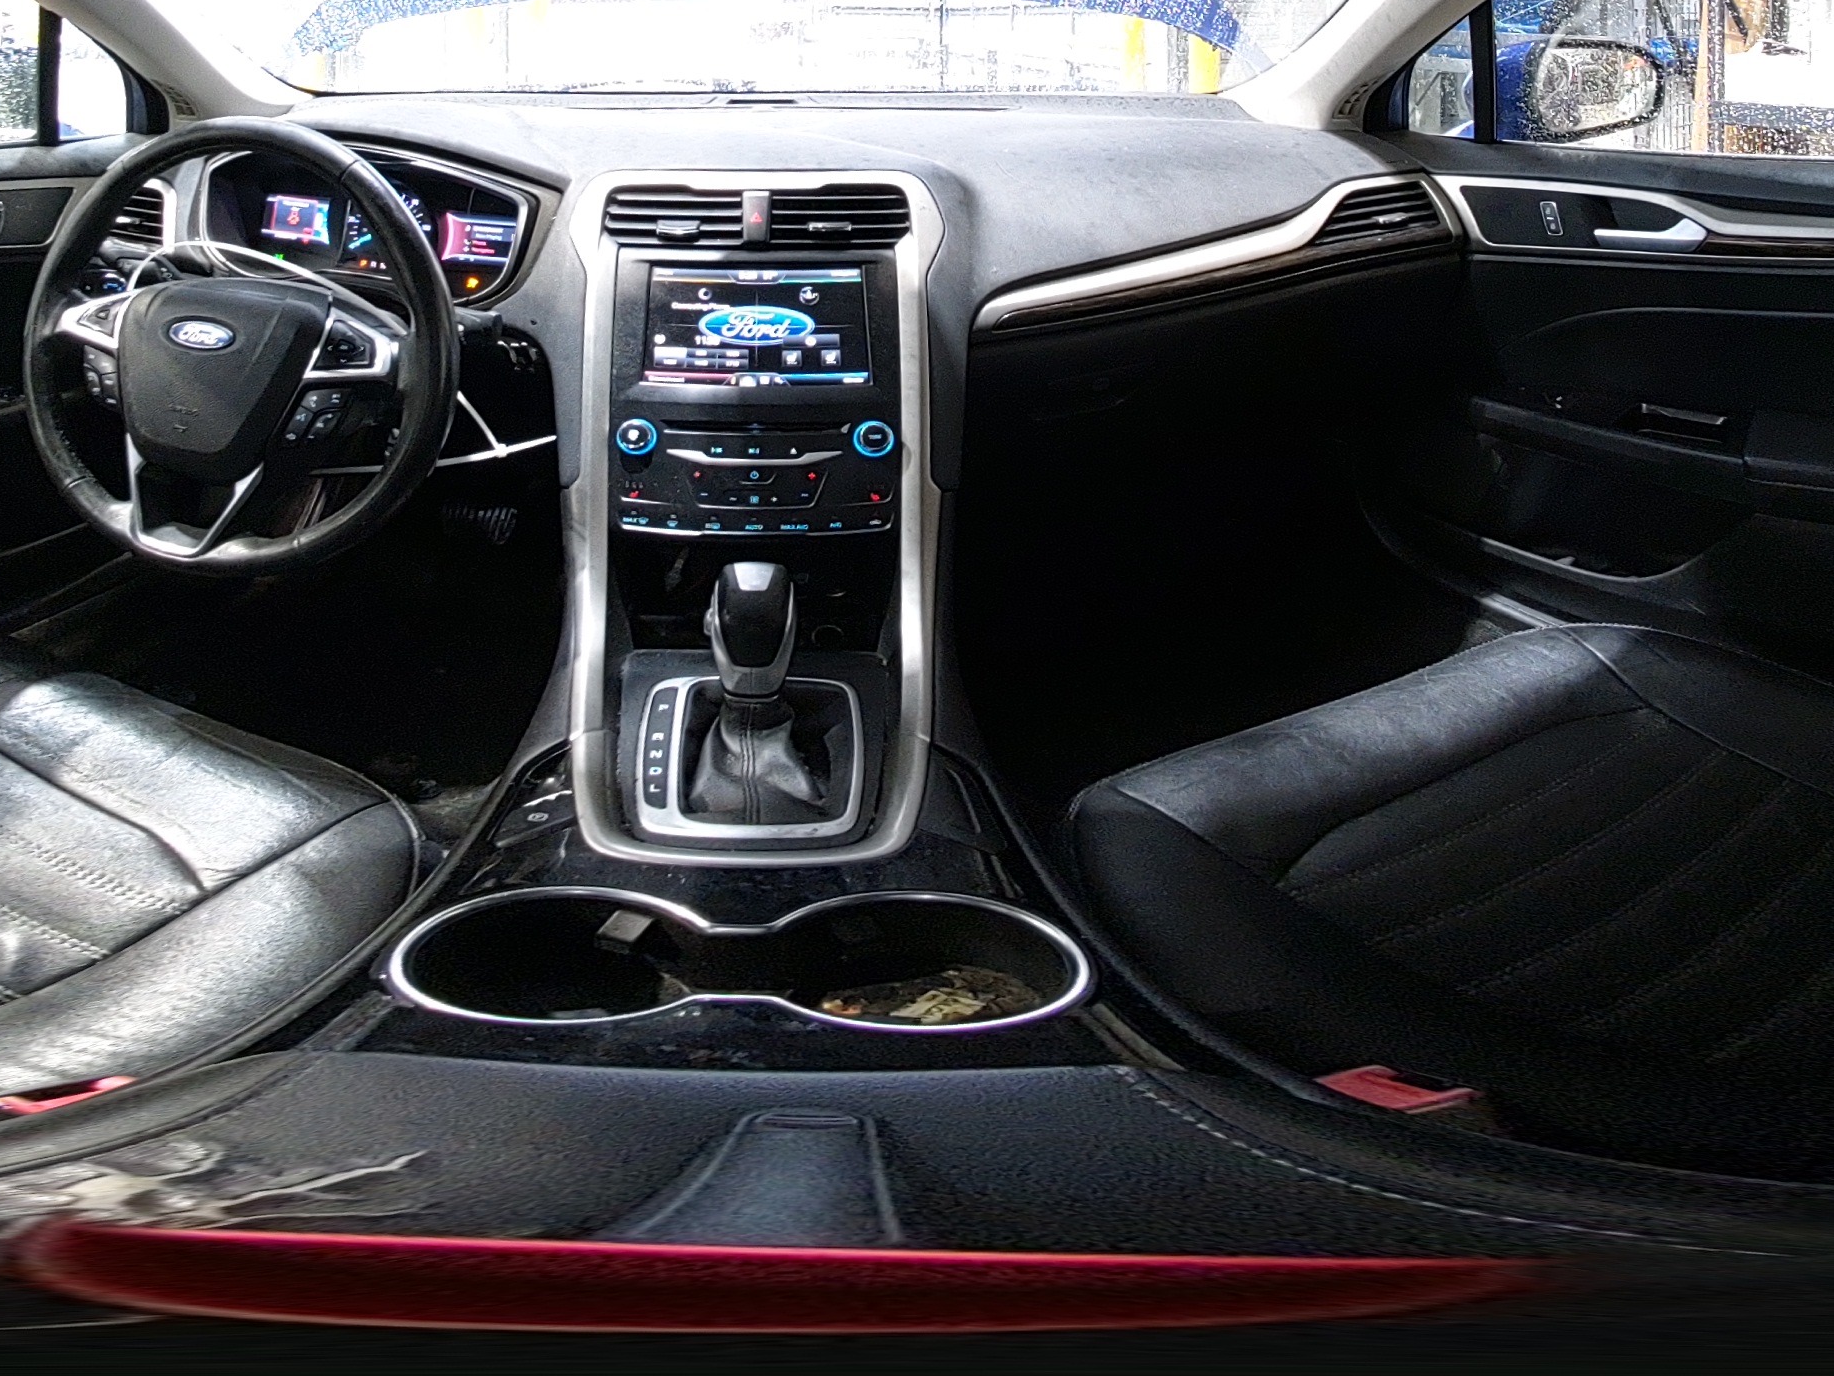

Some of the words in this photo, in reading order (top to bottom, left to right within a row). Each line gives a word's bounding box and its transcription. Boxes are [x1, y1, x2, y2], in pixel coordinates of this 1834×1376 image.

[721, 311, 792, 338] Ford
[649, 749, 664, 759] N
[649, 766, 663, 776] D
[649, 784, 662, 793] L
